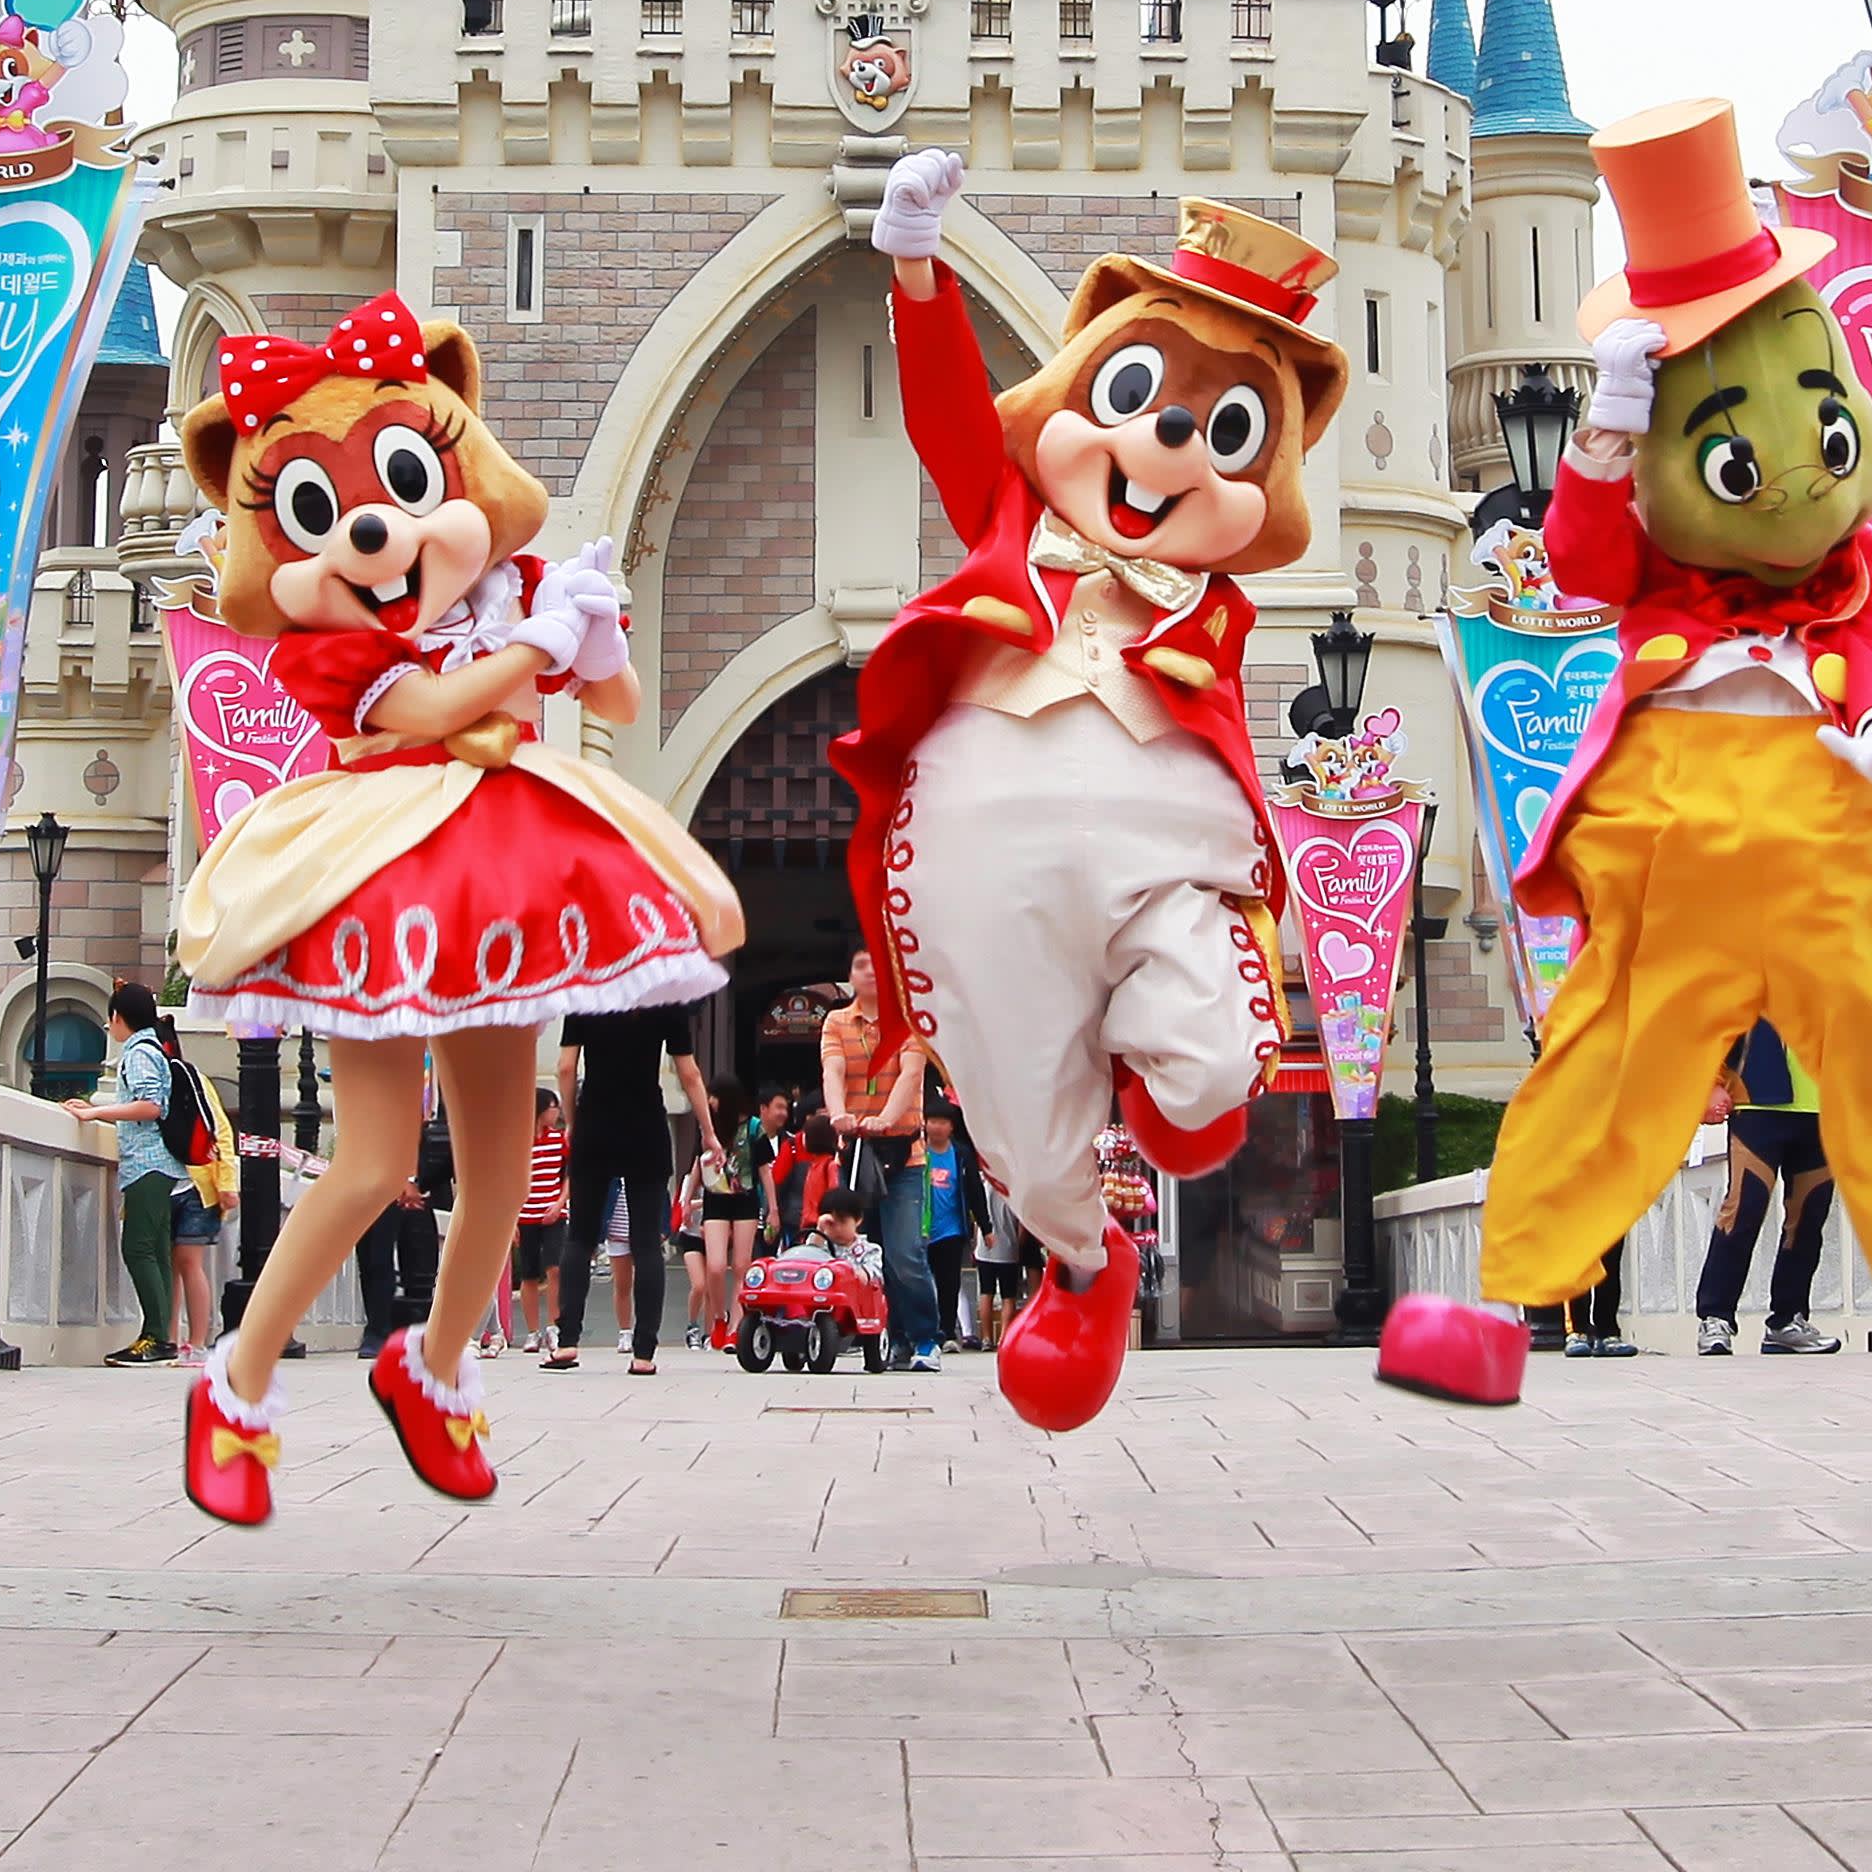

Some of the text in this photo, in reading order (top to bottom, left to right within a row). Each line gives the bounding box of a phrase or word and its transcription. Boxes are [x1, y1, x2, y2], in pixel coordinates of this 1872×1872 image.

[1511, 614, 1602, 628] LOTTE WORLD
[212, 680, 310, 746] Family
[1312, 858, 1389, 906] Family
